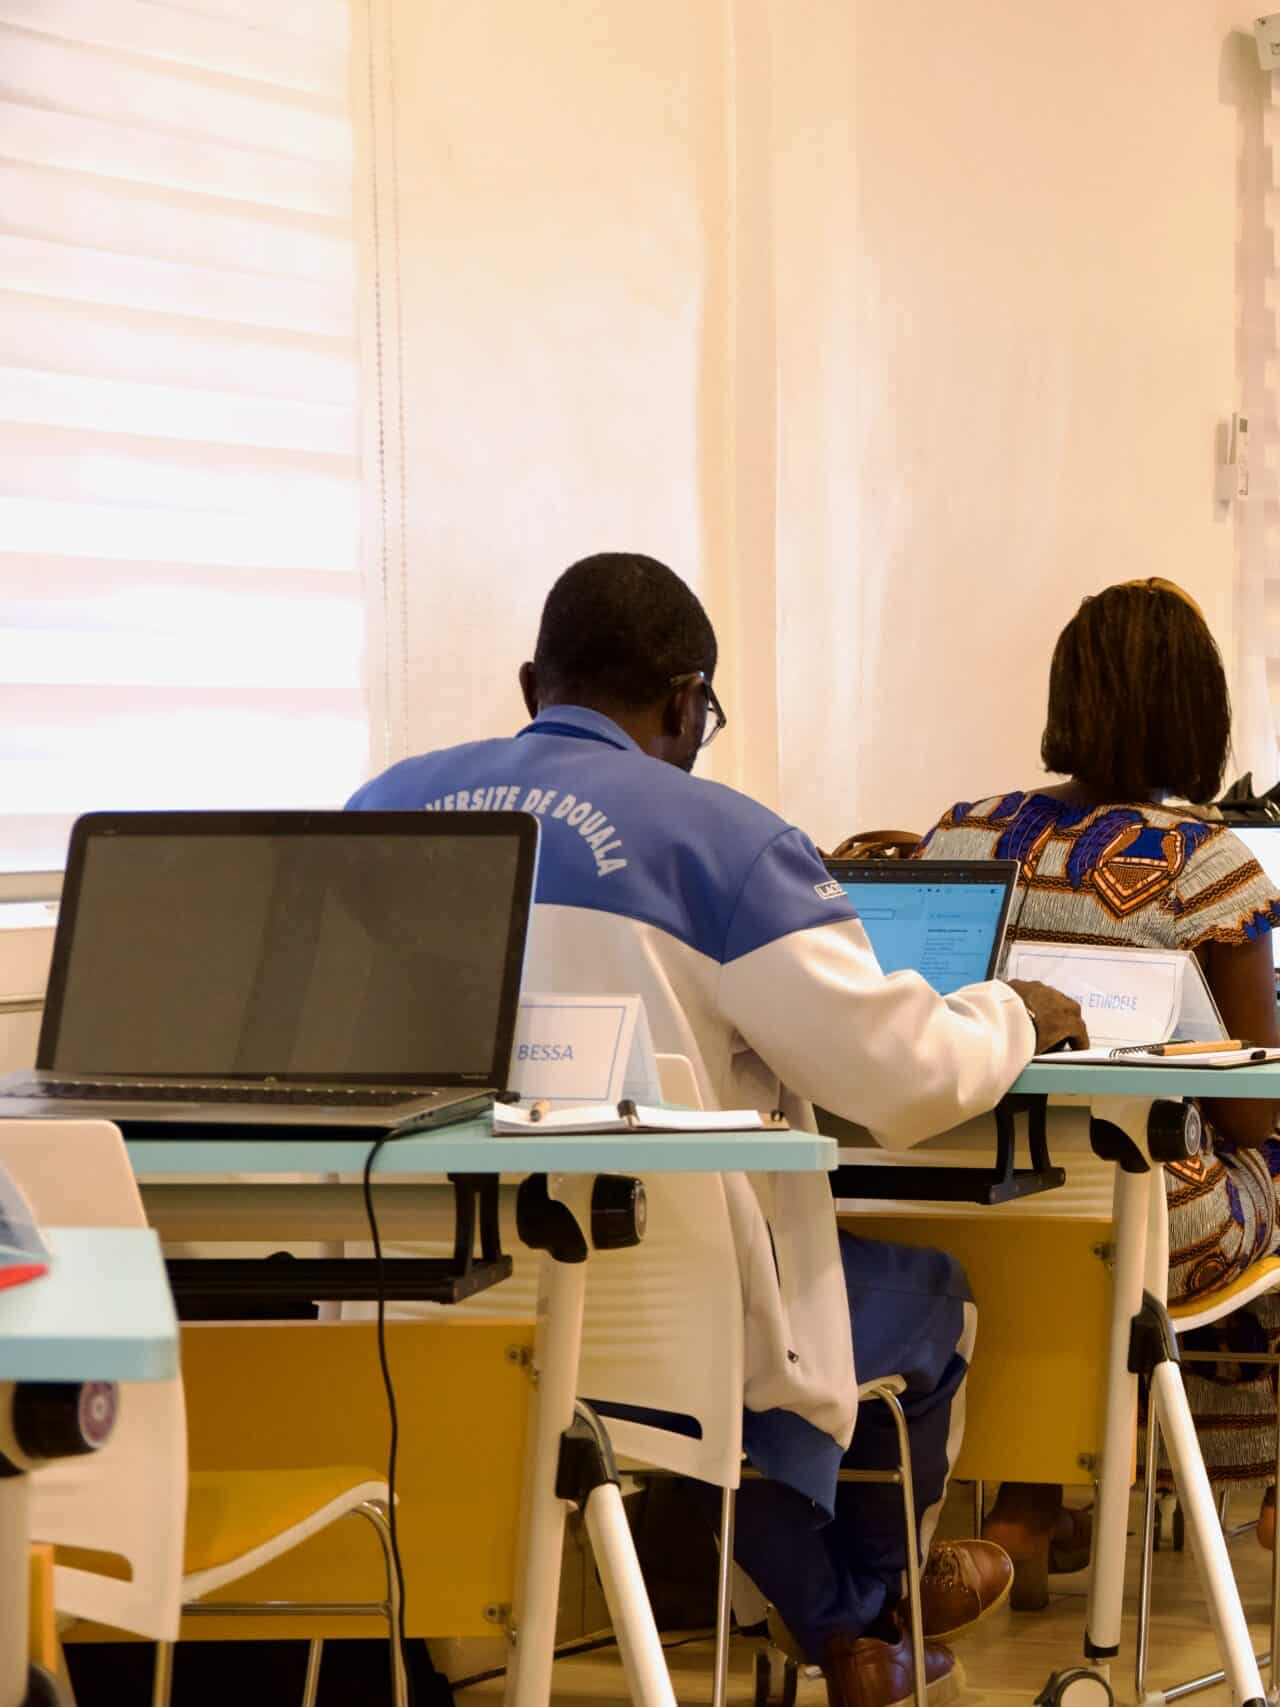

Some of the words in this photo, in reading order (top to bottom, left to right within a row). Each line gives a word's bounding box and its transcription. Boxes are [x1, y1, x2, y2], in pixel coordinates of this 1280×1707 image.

[425, 786, 520, 811] ERSITE
[521, 788, 558, 815] DE
[552, 794, 627, 877] DOUALA
[518, 1044, 573, 1061] BESSA
